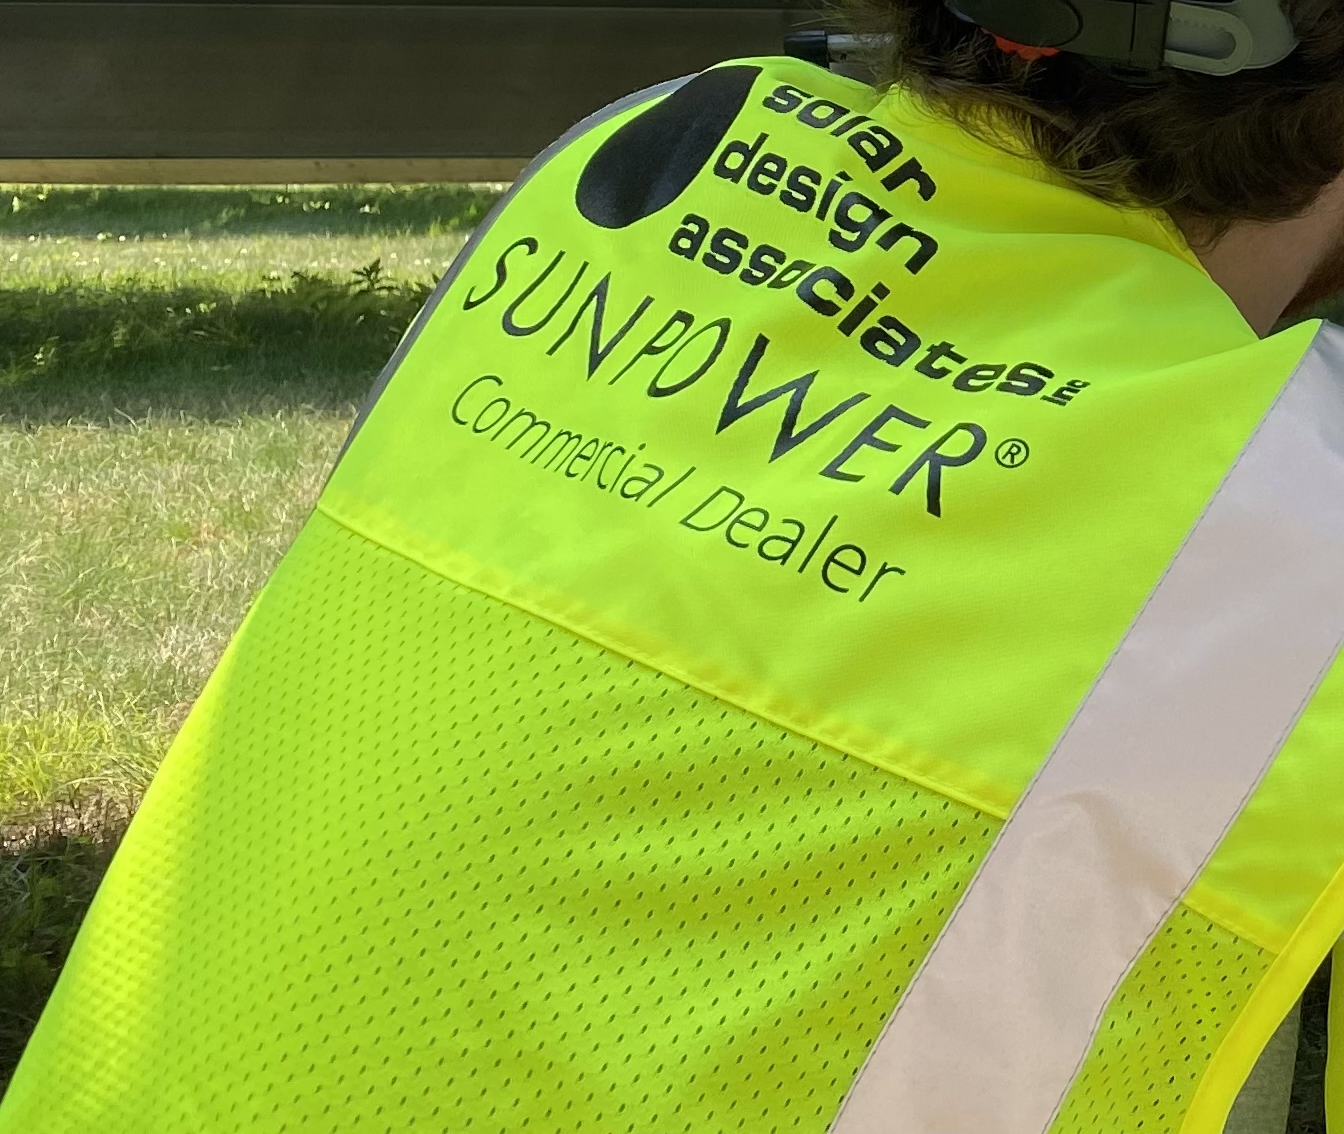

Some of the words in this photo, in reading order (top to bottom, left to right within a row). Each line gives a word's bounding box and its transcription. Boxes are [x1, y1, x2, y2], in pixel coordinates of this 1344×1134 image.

[712, 132, 940, 275] design
[762, 84, 937, 201] solar
[668, 213, 1055, 396] associates
[451, 374, 697, 509] Commercial
[678, 484, 906, 603] Dealer
